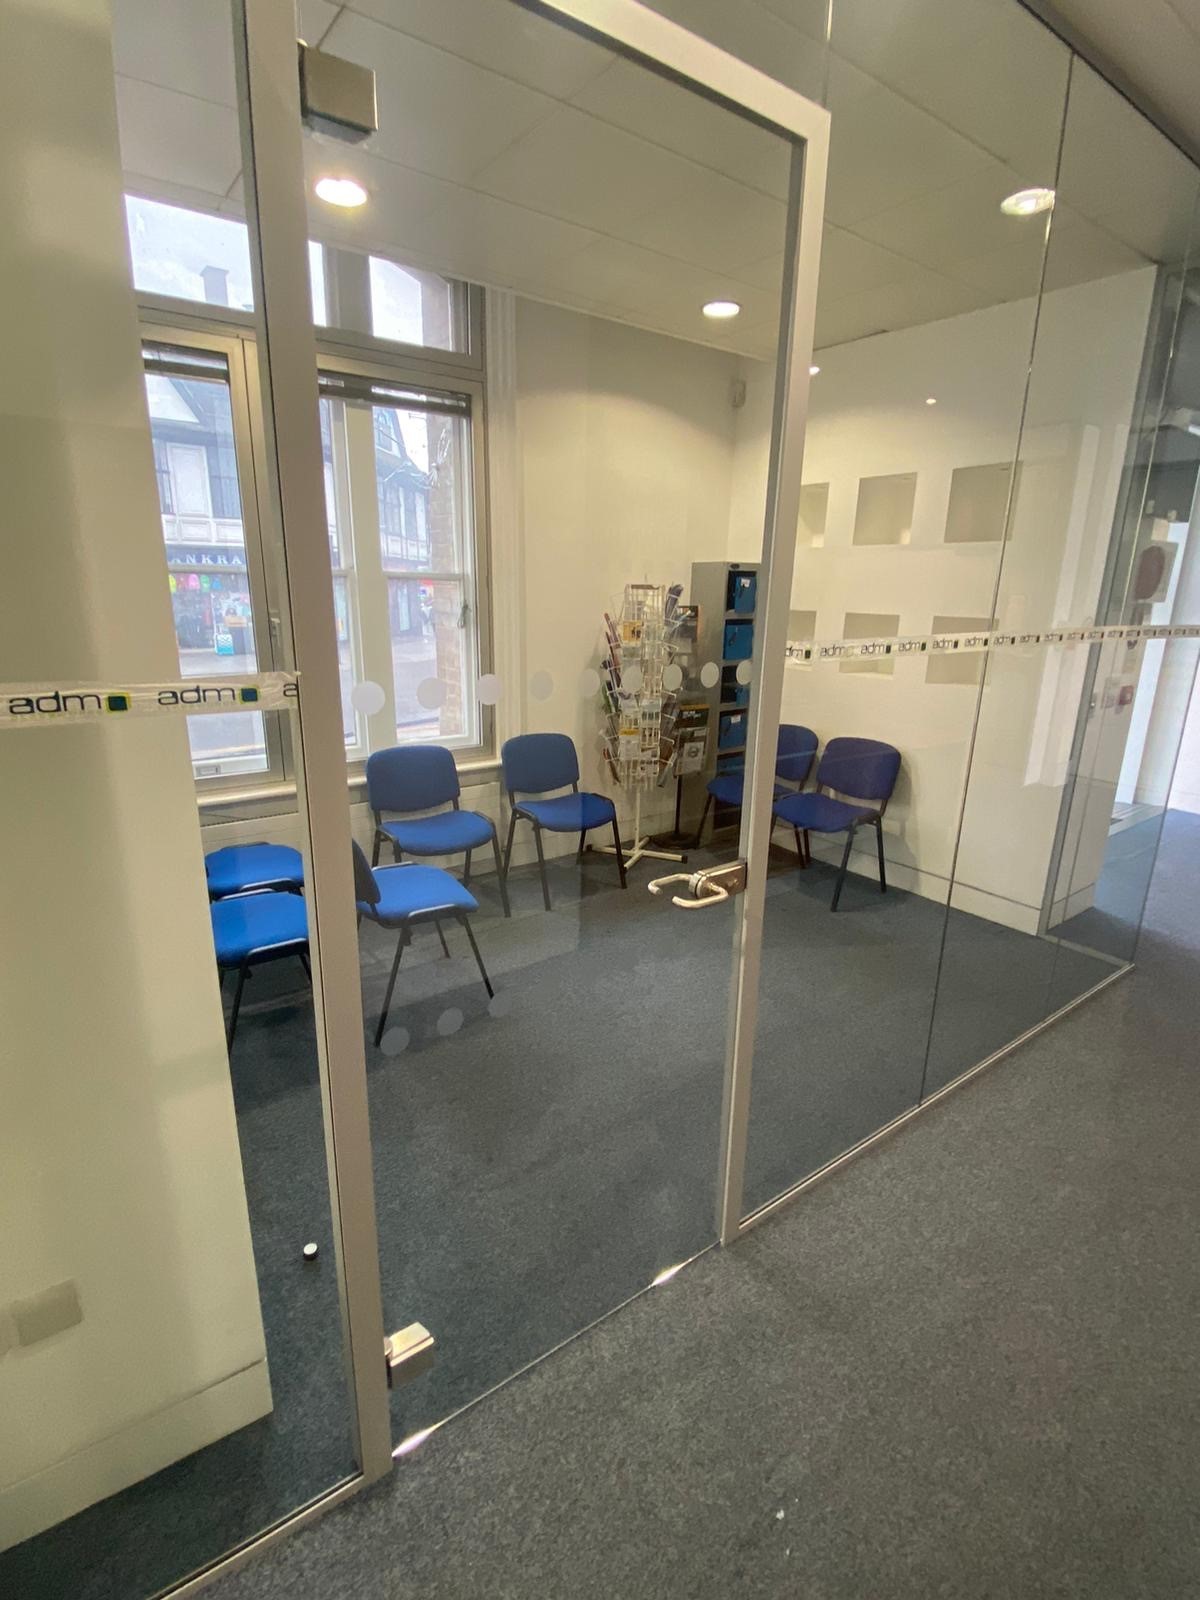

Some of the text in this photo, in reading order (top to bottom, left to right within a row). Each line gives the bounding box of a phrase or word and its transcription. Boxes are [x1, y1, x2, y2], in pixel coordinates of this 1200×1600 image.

[820, 644, 846, 657] adm
[860, 642, 885, 655] adm
[898, 640, 920, 652] adm
[932, 638, 953, 649] adm
[964, 636, 983, 647] adm
[9, 691, 102, 714] adm
[158, 685, 236, 705] adm
